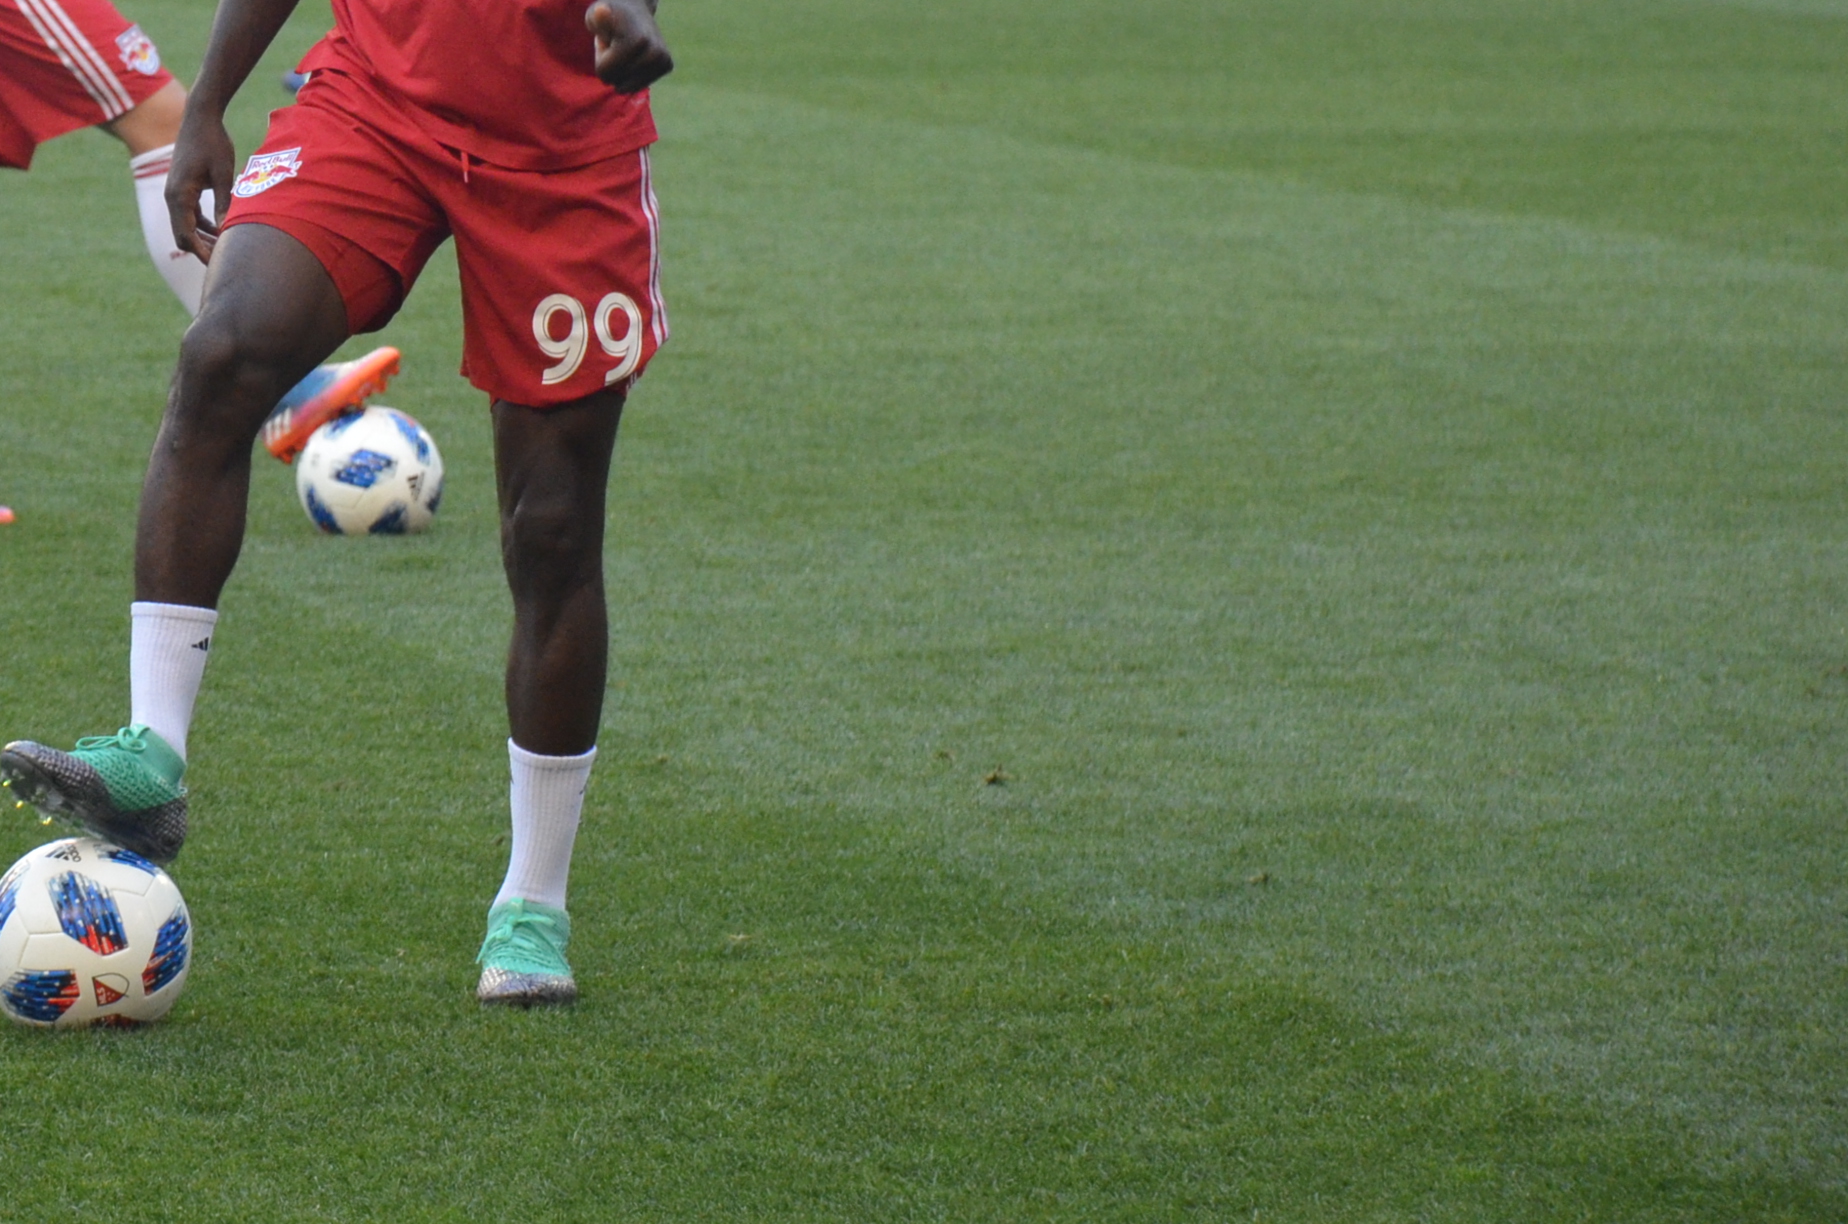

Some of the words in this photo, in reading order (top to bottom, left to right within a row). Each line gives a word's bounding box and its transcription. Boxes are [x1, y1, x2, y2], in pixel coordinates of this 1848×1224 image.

[253, 157, 273, 169] Red
[272, 154, 295, 163] Bull
[532, 291, 643, 387] 99
